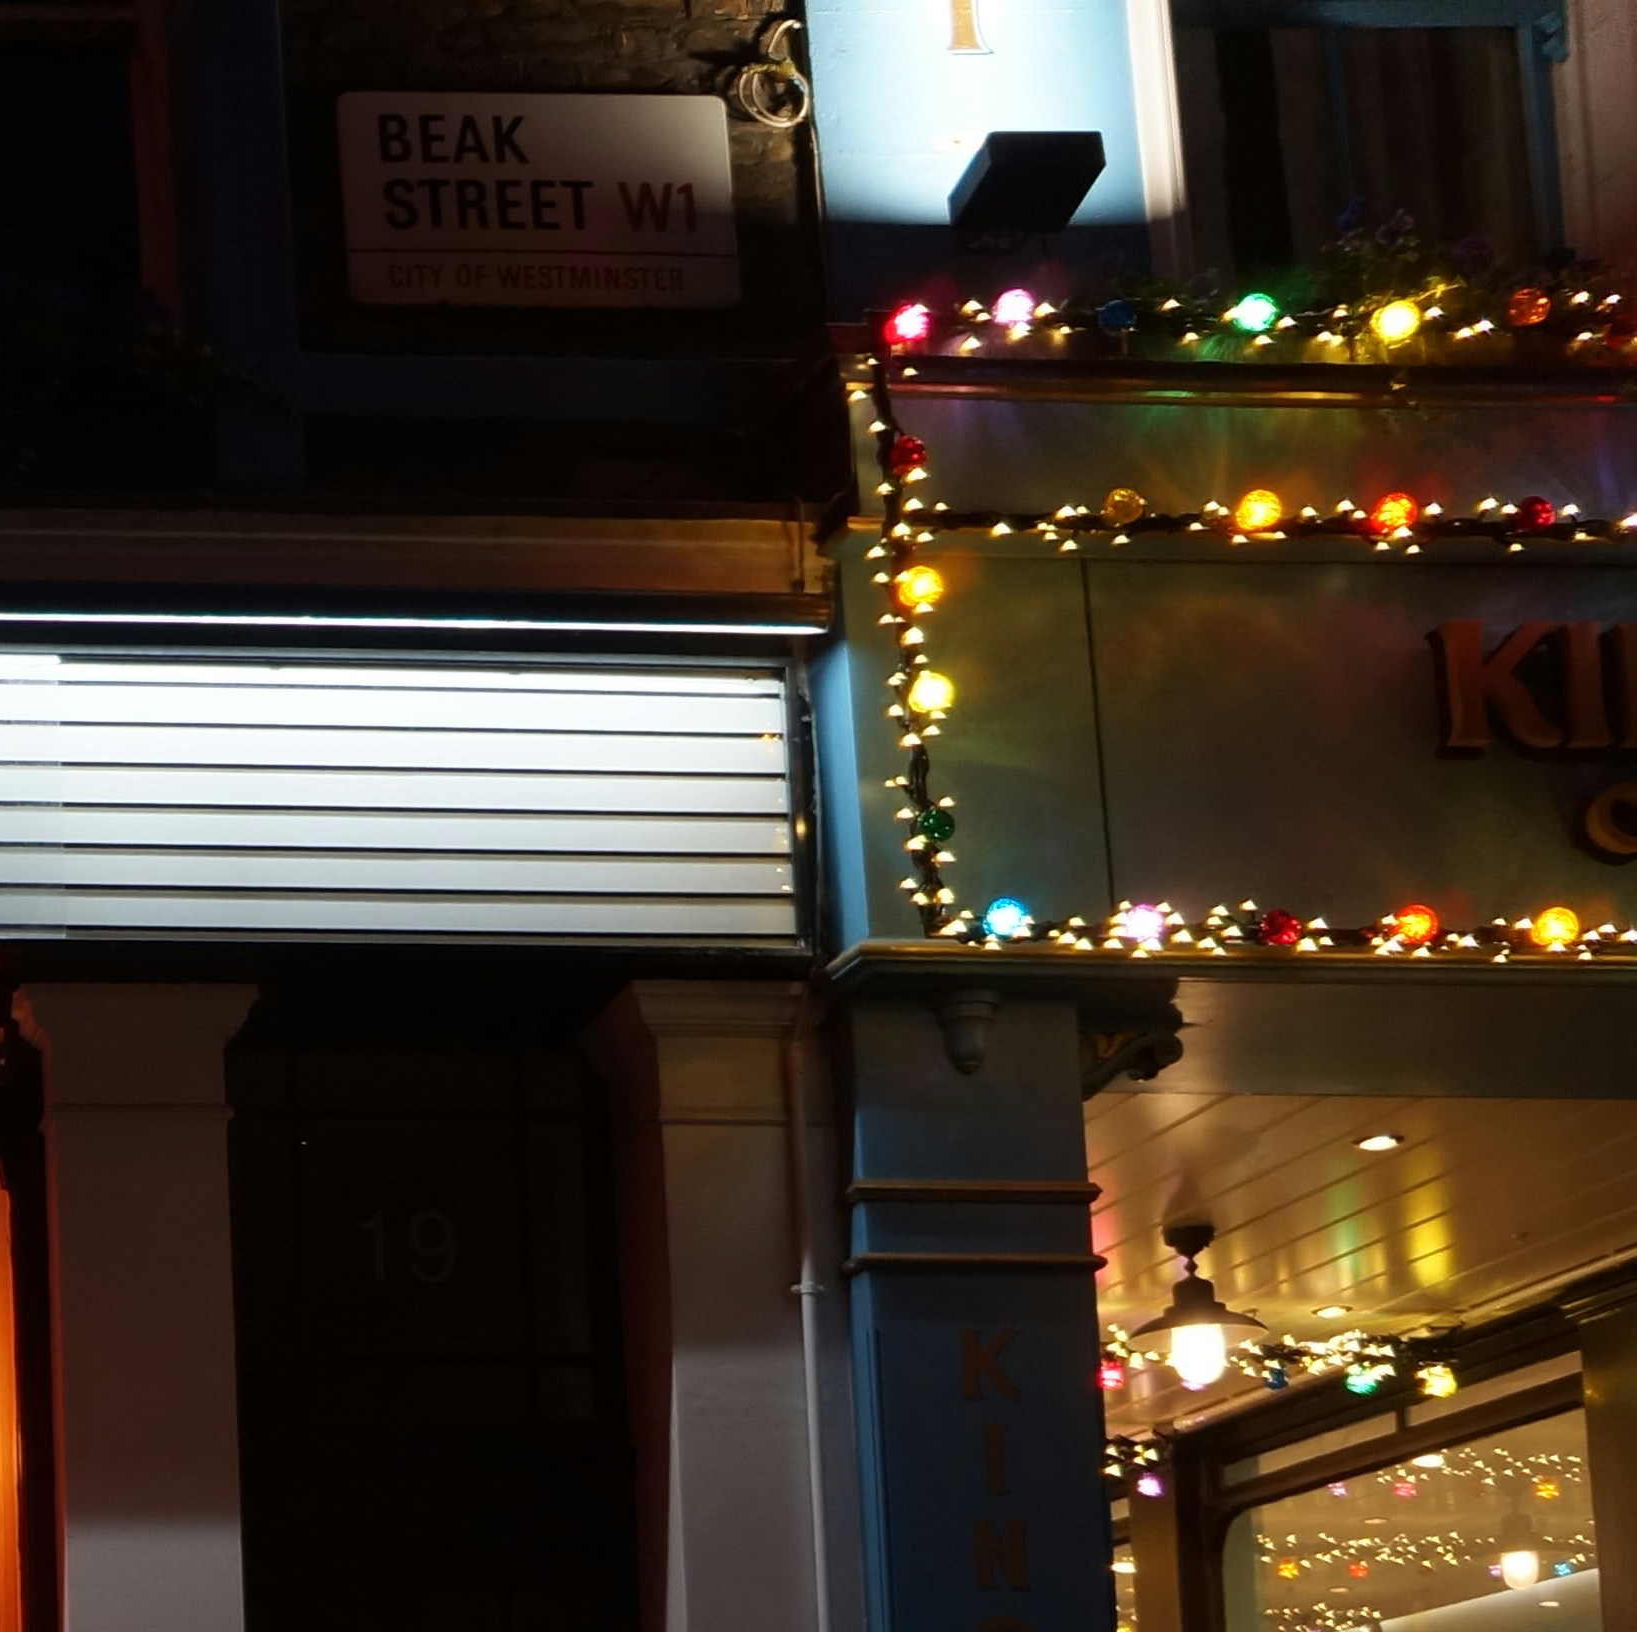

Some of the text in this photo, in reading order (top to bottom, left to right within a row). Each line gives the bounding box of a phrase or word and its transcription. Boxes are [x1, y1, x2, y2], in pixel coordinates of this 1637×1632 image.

[378, 113, 528, 165] BEAK
[383, 178, 697, 233] STREET W1
[388, 263, 685, 292] CITY OF WESTMINSTER
[1429, 618, 1637, 757] KI
[356, 1209, 459, 1284] 19
